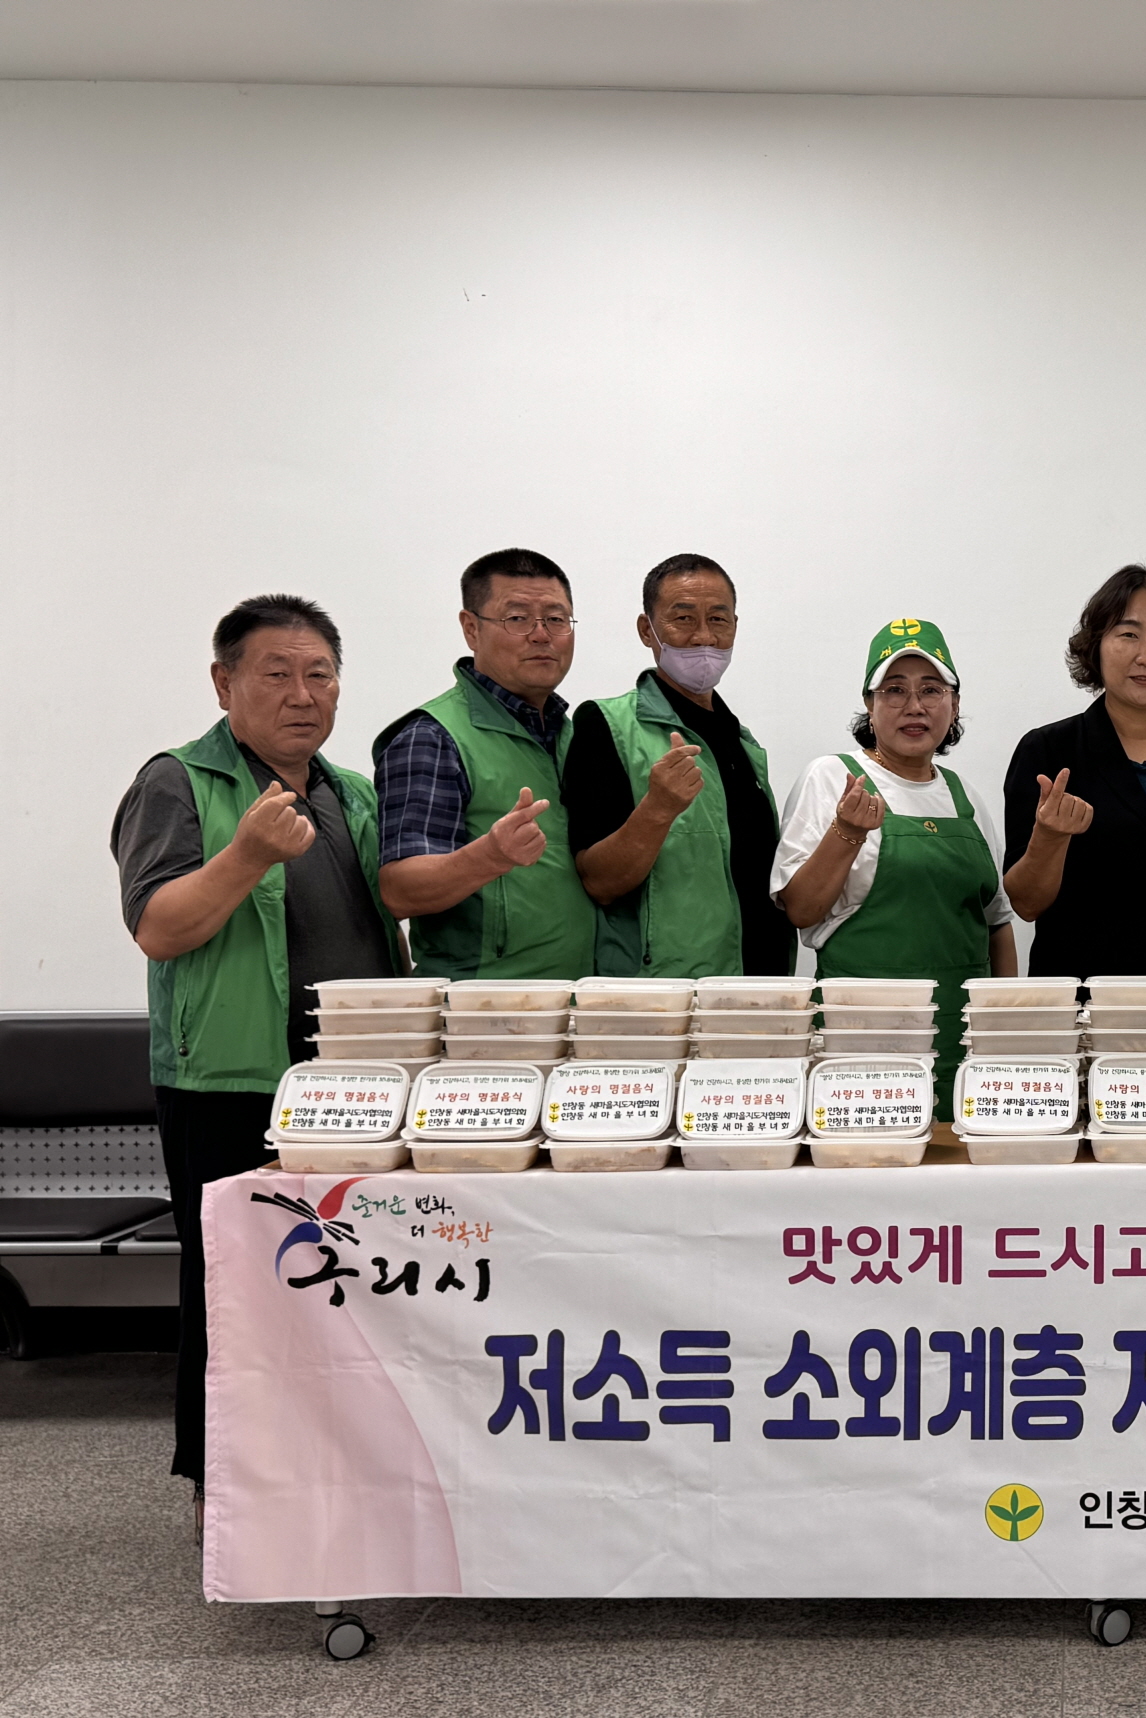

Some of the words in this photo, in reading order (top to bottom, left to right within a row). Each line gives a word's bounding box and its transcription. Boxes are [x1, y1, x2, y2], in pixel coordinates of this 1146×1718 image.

[567, 1085, 601, 1095] 사랑의
[981, 1081, 1013, 1091] 사랑의
[1108, 1084, 1139, 1094] 사랑의
[301, 1091, 336, 1102] 사랑의
[435, 1093, 470, 1102] 사랑의
[701, 1095, 734, 1105] 사랑의
[831, 1089, 864, 1100] 사랑의
[352, 1194, 406, 1218] 즐거운
[410, 1225, 424, 1238] 더
[431, 1222, 493, 1248] 행복한
[782, 1225, 963, 1285] 맛있게
[287, 1245, 490, 1307] 구리시
[484, 1328, 734, 1442] 저소득
[763, 1324, 1087, 1440] 소외계층
